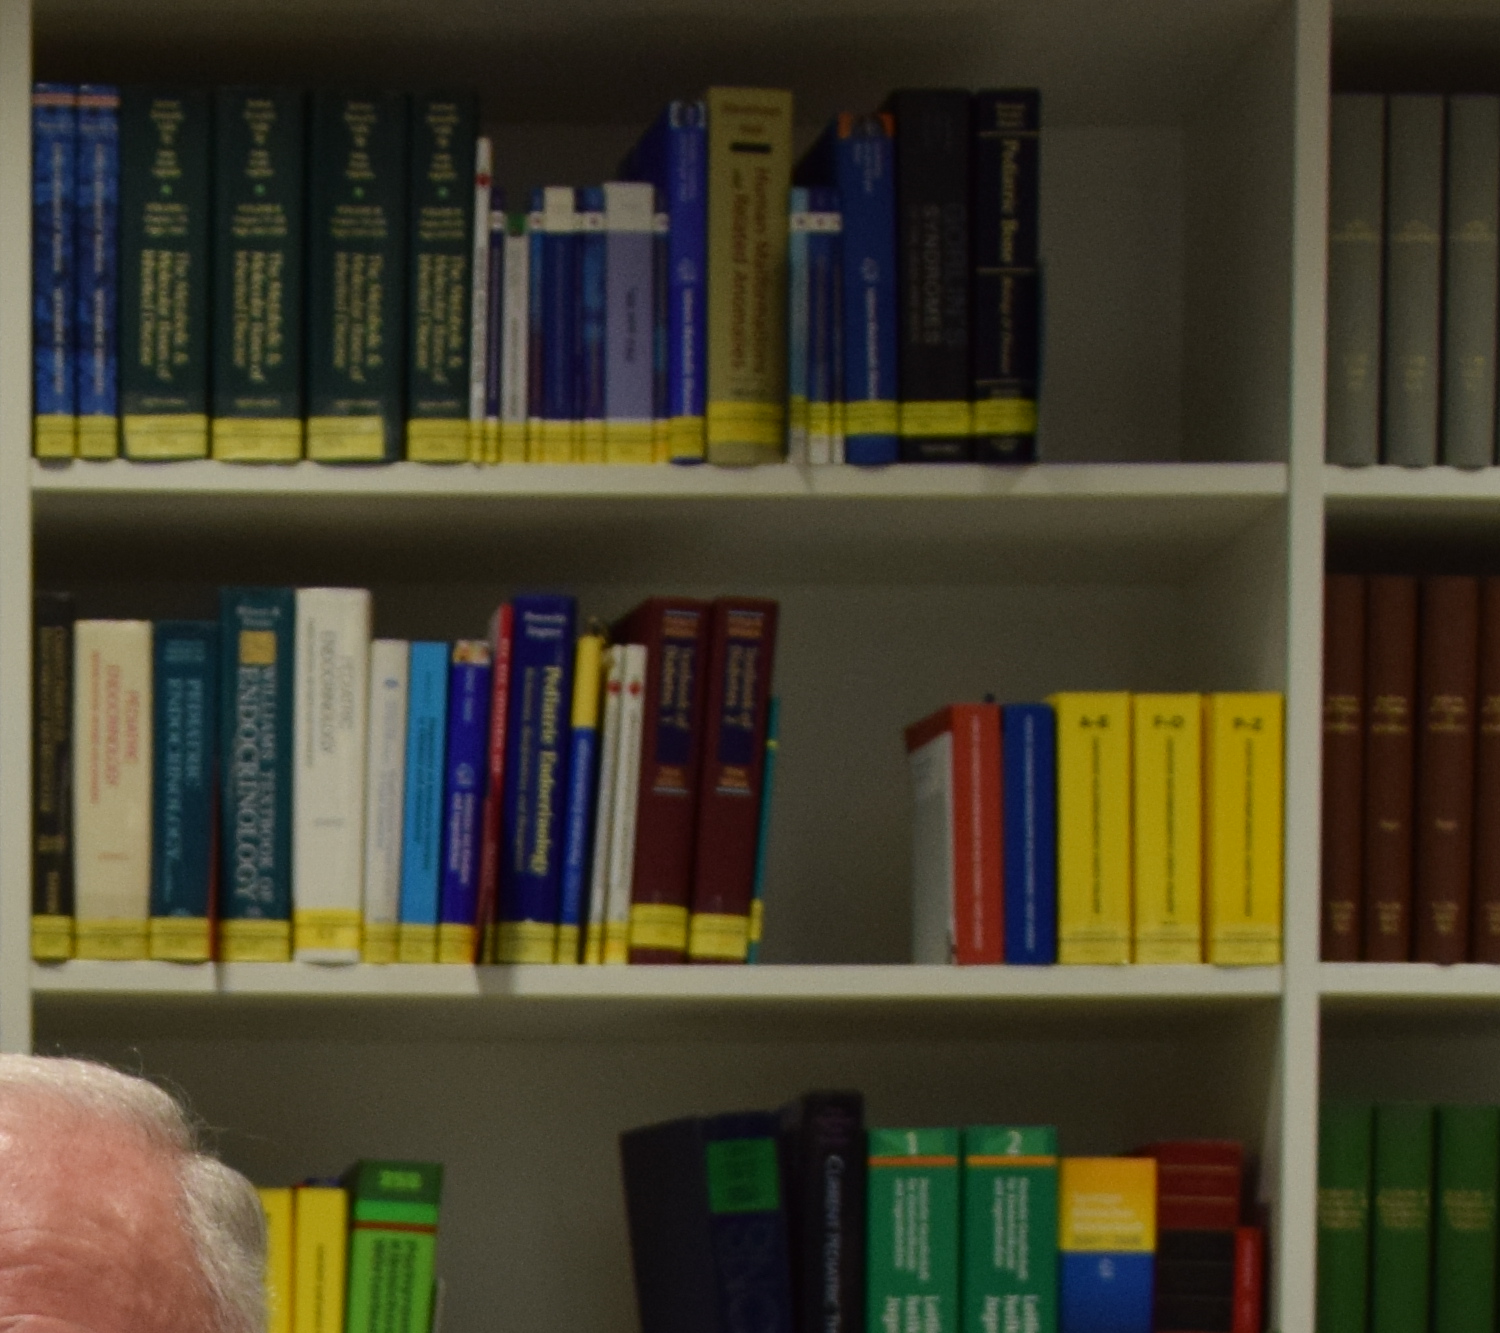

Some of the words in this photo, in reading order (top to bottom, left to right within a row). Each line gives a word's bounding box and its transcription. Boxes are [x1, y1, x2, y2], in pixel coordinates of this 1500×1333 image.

[754, 165, 771, 235] Human
[999, 138, 1021, 215] Pediatric
[733, 194, 749, 265] Related
[1000, 218, 1020, 264] Bone
[754, 240, 771, 374] Malformations
[921, 203, 942, 347] SYNDROMES
[943, 201, 967, 347] GORLIN'S
[731, 269, 749, 371] Anomalies
[258, 665, 279, 761] WILLIAMS
[539, 664, 563, 745] Pediatric
[660, 645, 678, 709] Diabetes
[724, 645, 742, 709] Diabetes
[233, 664, 261, 900] ENDOCRINOLOGY
[259, 769, 277, 869] TEXTBOOK
[528, 749, 558, 877] Endocrinology
[259, 876, 275, 905] OF
[906, 1131, 919, 1156] 1
[1006, 1131, 1021, 1156] 2
[823, 1153, 844, 1227] CURRENT
[823, 1232, 842, 1308] PEDIATRIC
